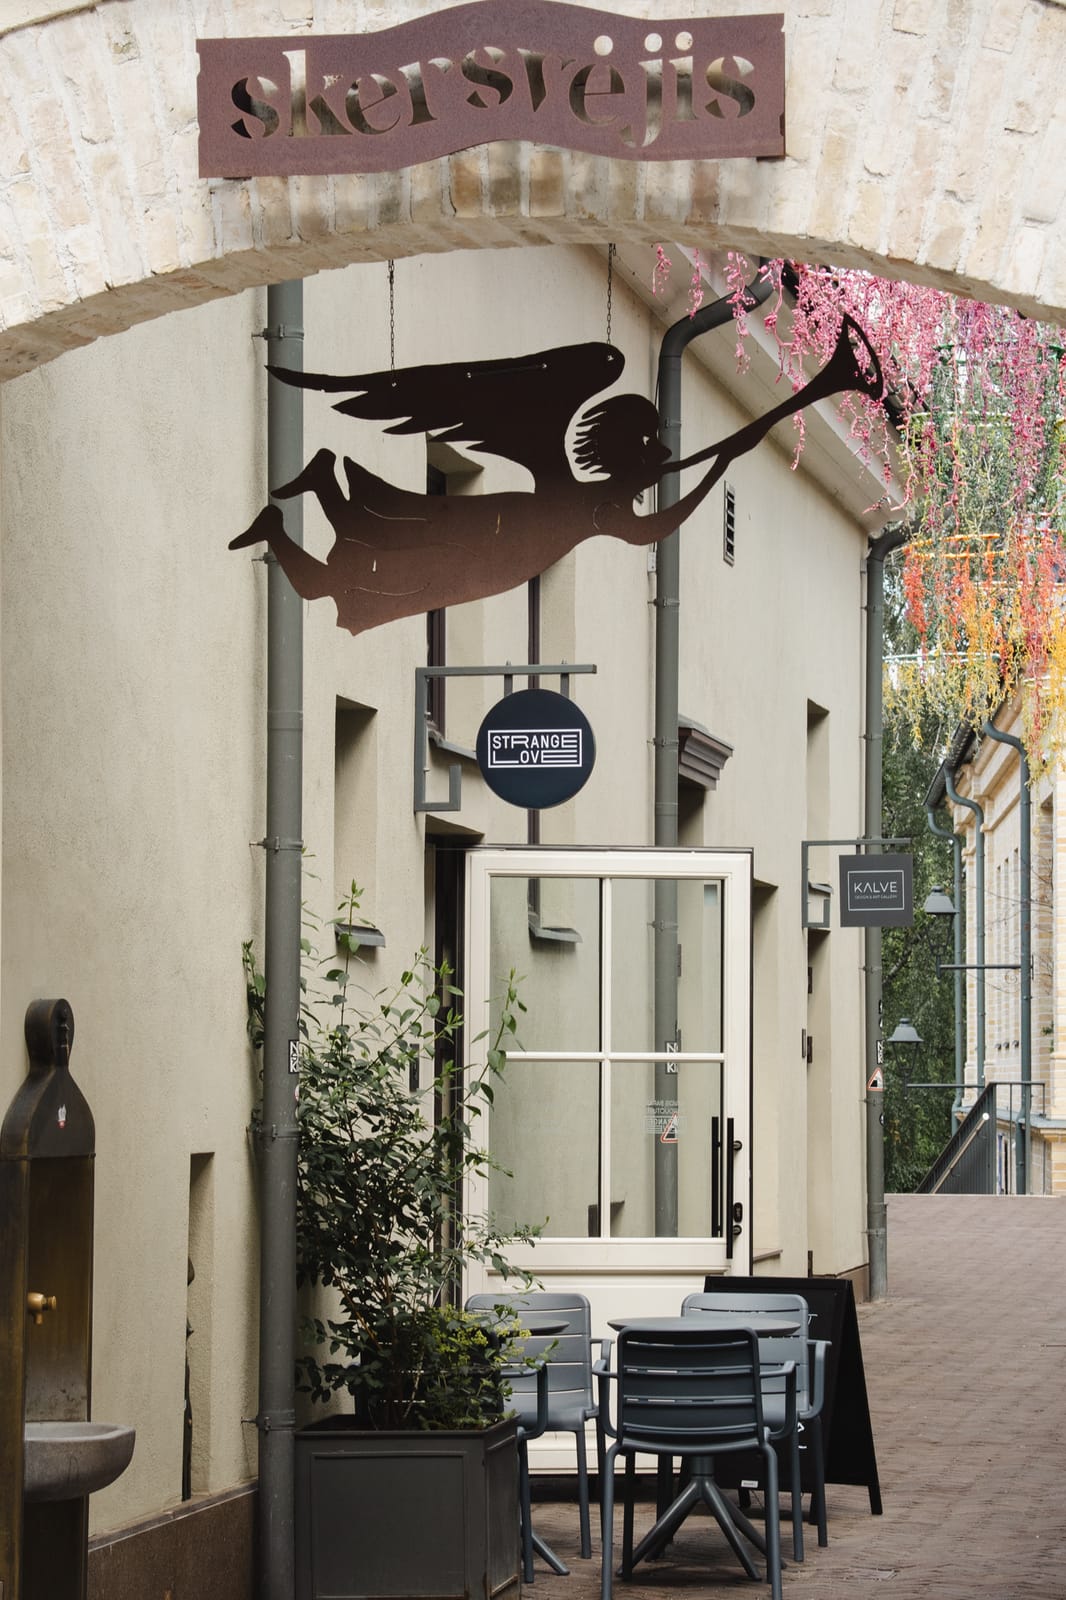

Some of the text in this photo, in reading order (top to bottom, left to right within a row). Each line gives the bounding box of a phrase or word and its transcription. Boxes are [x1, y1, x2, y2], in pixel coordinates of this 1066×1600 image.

[230, 31, 756, 148] skersvėjis
[492, 734, 578, 750] STRANGE
[492, 749, 578, 764] LOVE
[853, 881, 898, 893] KALVE
